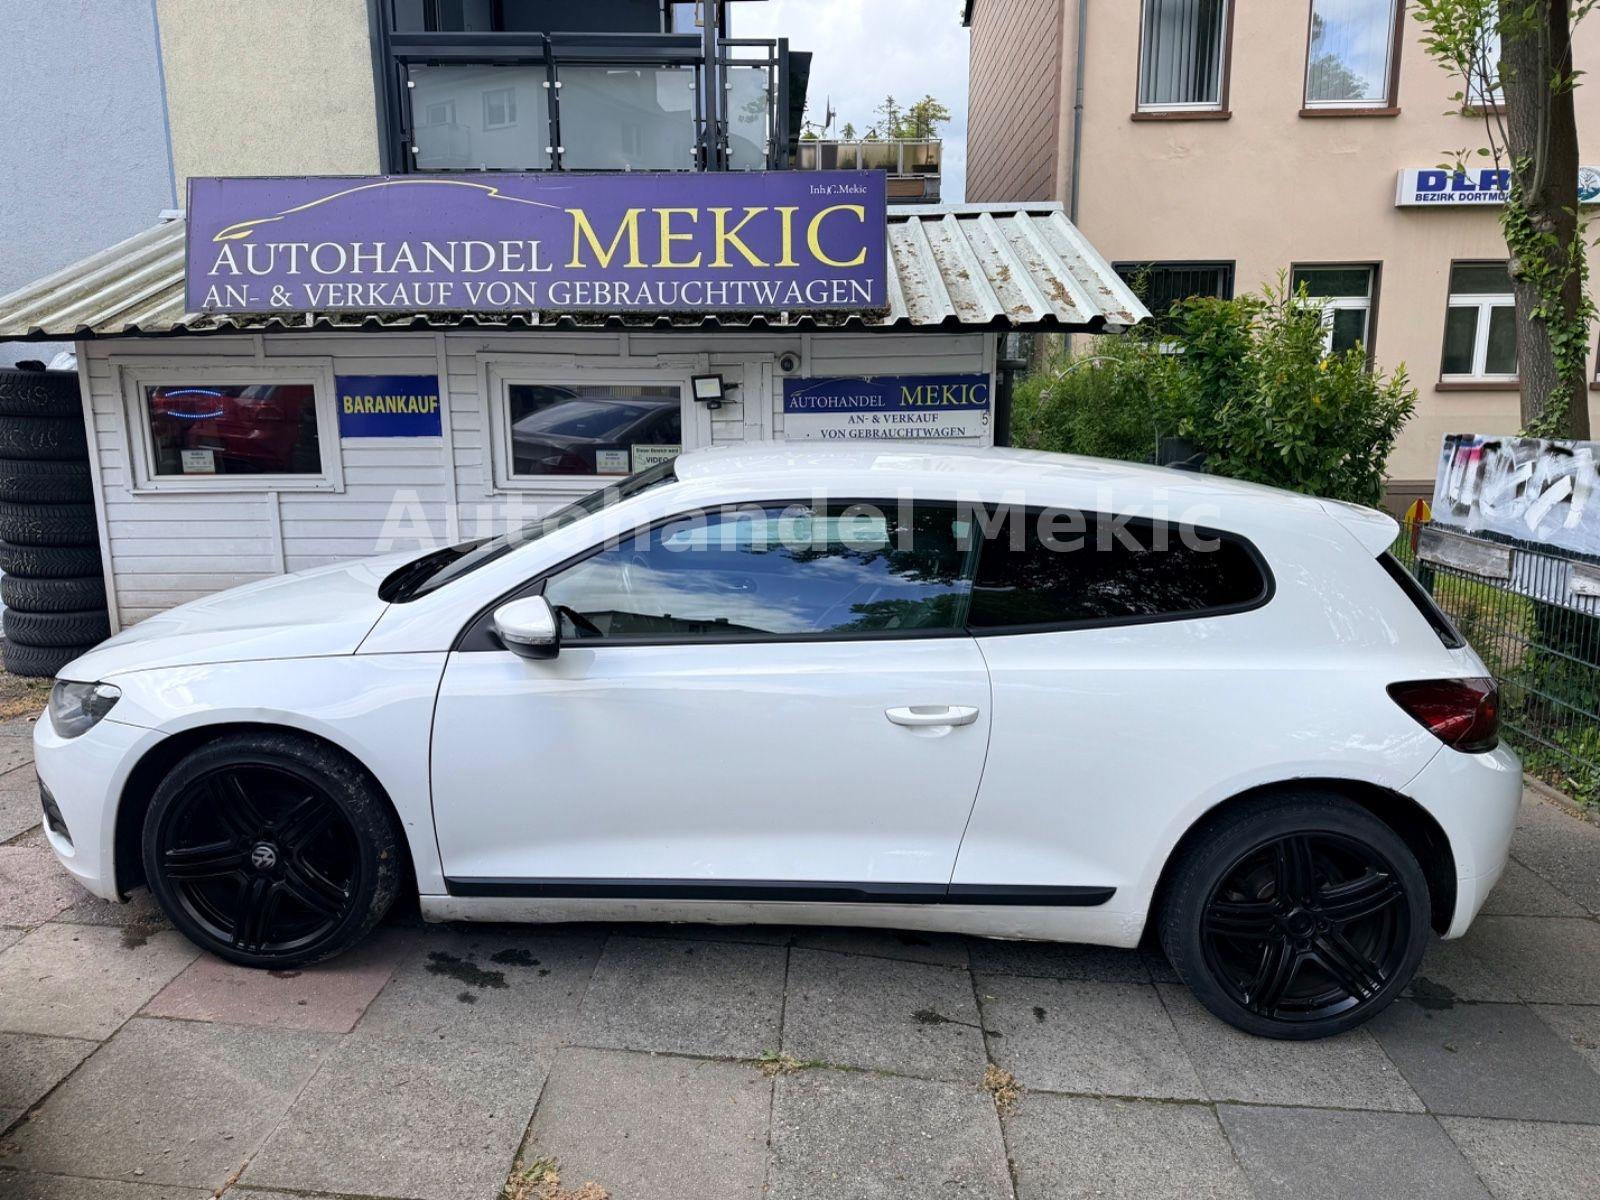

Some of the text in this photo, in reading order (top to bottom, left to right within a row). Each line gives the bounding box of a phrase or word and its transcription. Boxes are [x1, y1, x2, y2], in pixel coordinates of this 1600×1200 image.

[1416, 170, 1510, 192] DLR
[1415, 192, 1510, 202] BEZIRK DORTMU
[207, 204, 868, 277] AUTOHANDEL MEKIC
[201, 278, 874, 308] AN- & VERKAUF VON GEBRAUCHTWAGEN
[343, 395, 437, 414] BARANKAUF
[789, 383, 988, 408] AUTOHANDEL MEKIC
[848, 413, 939, 424] AN- & VERKAUF
[981, 412, 989, 426] 5
[820, 426, 966, 439] VON GEBRAUCHTWAGEN
